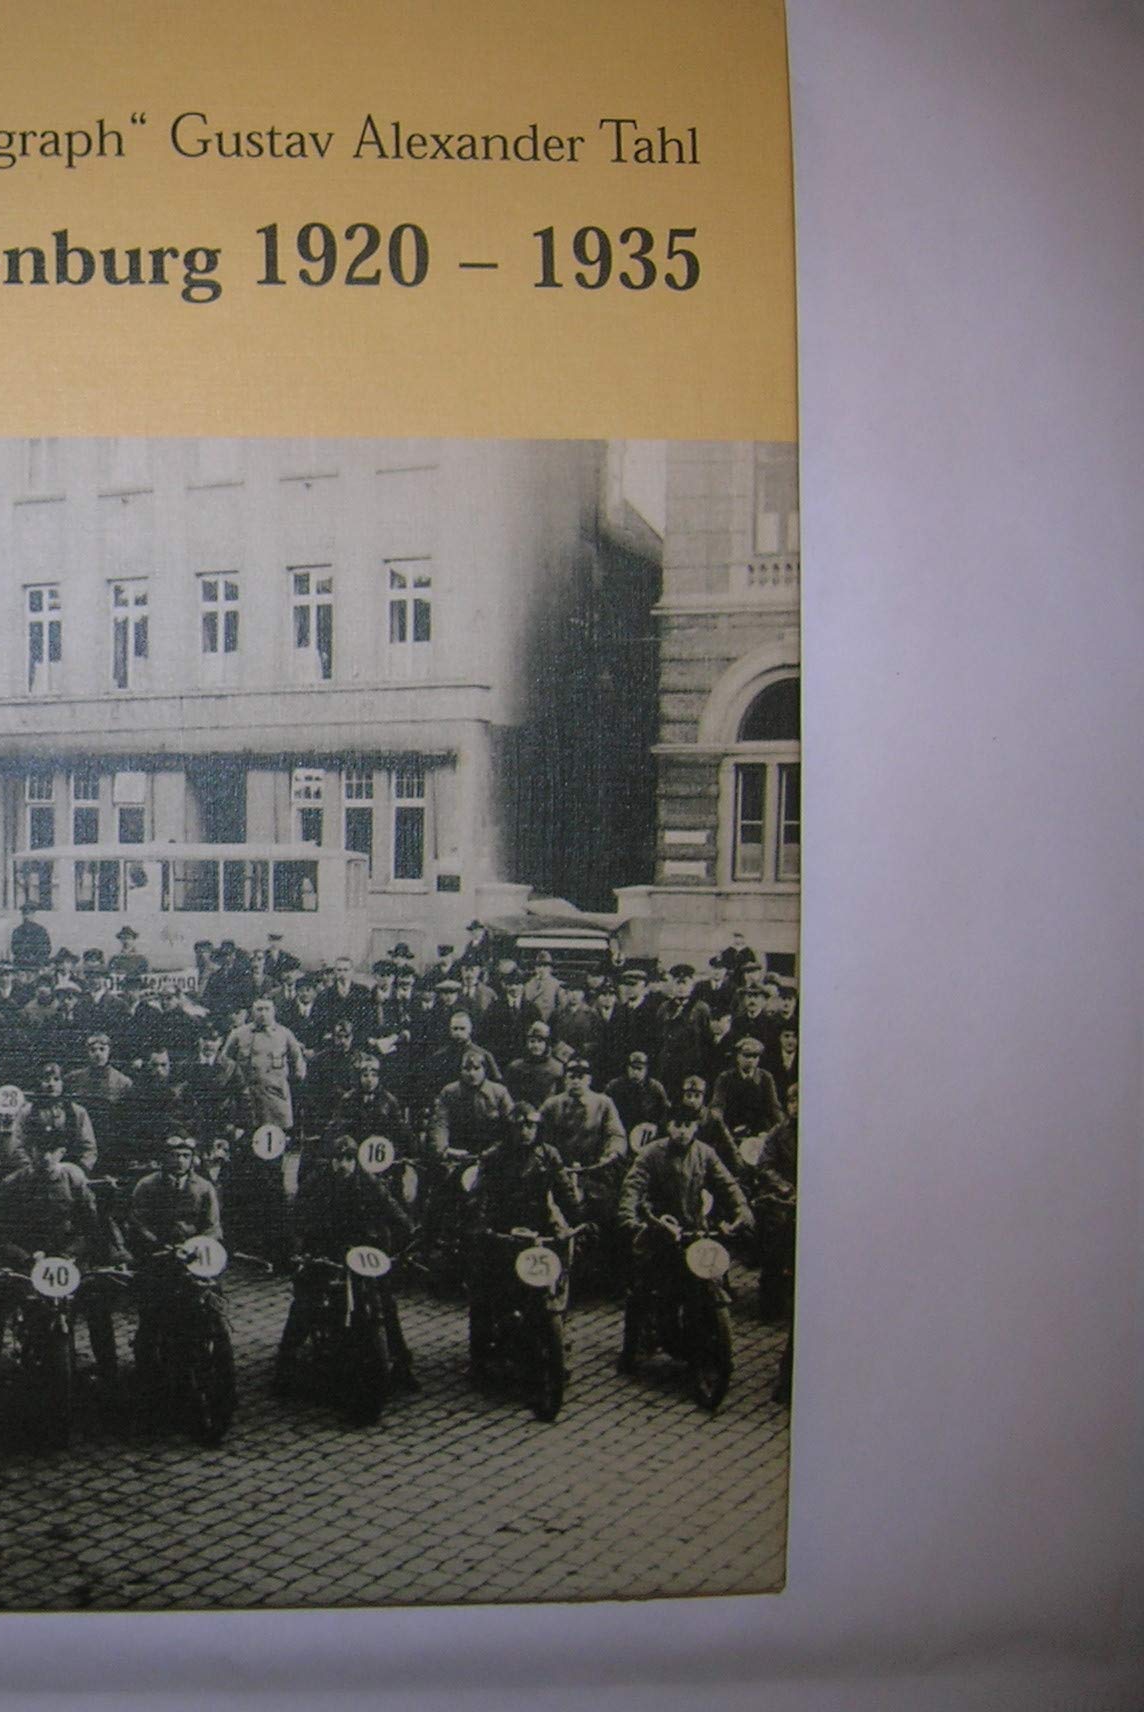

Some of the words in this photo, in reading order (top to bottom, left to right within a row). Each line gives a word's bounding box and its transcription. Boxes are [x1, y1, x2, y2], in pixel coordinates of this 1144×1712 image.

[170, 111, 335, 159] Gustav
[352, 113, 586, 163] Alexander
[599, 117, 701, 165] Tahl
[256, 221, 430, 288] 1920
[532, 225, 701, 291] 1935
[367, 1142, 386, 1163] 16
[358, 1252, 380, 1269] 10
[526, 1253, 551, 1277] 25
[42, 1265, 69, 1287] 40
